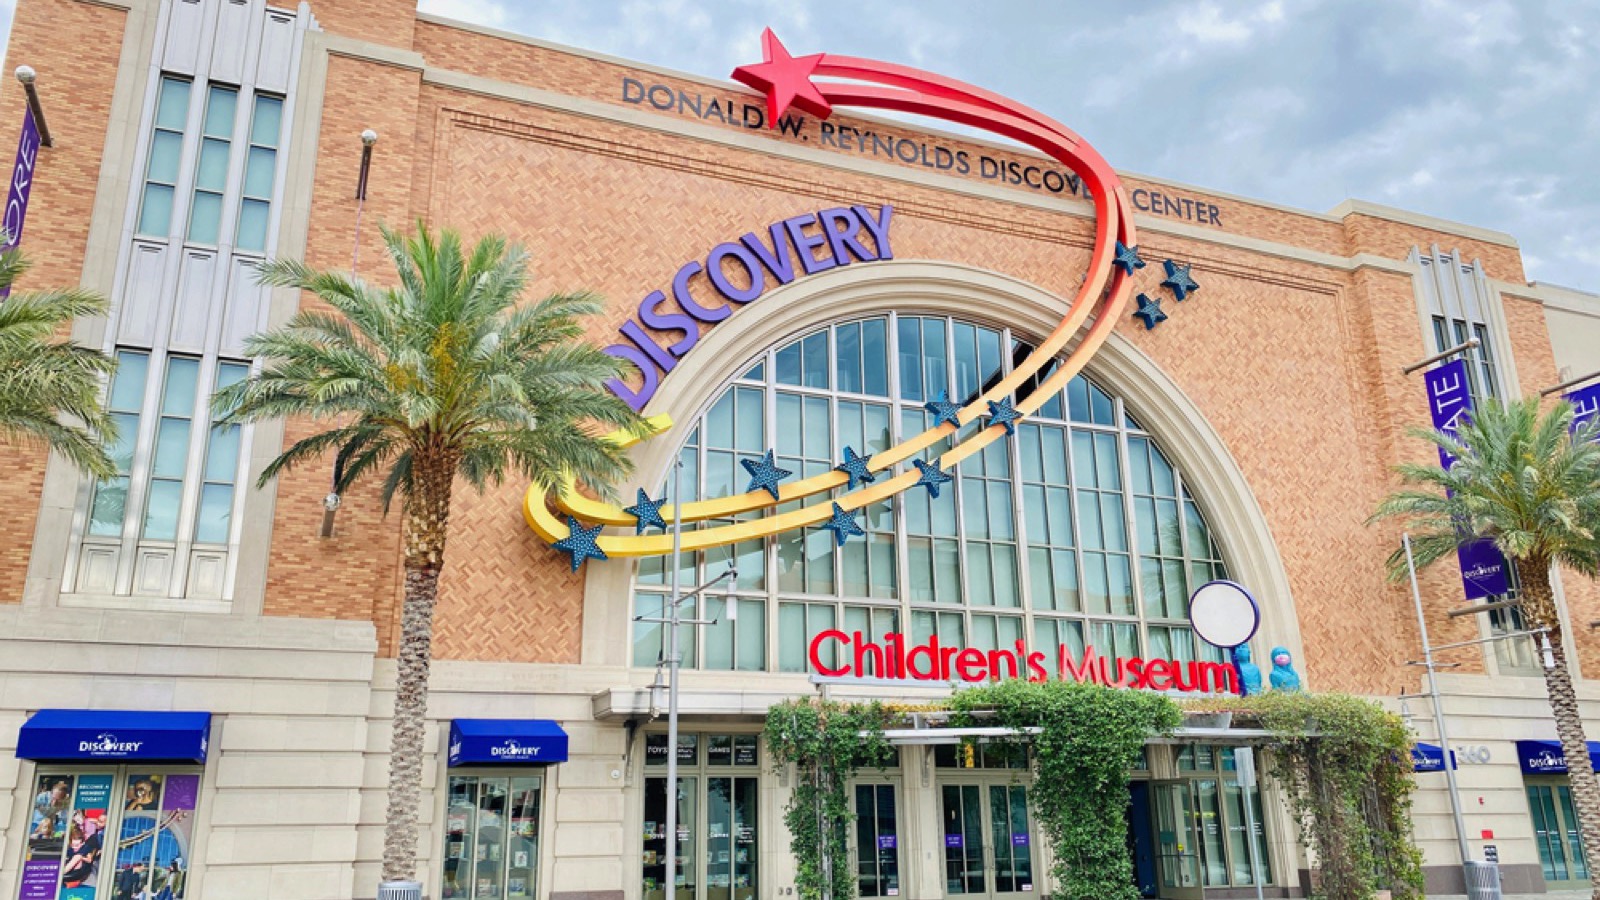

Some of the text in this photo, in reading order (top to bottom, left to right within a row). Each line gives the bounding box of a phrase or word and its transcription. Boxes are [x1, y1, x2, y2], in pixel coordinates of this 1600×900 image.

[623, 77, 1223, 227] DONALD W. REYNOLDS DISCOV CENTER
[601, 204, 894, 413] DISCOVERY
[1464, 565, 1500, 578] DISCOVERY
[809, 629, 1240, 694] Children's Museum
[79, 741, 142, 751] DISCOVERY
[490, 747, 540, 756] DISCOVERY
[1457, 745, 1490, 764] 360
